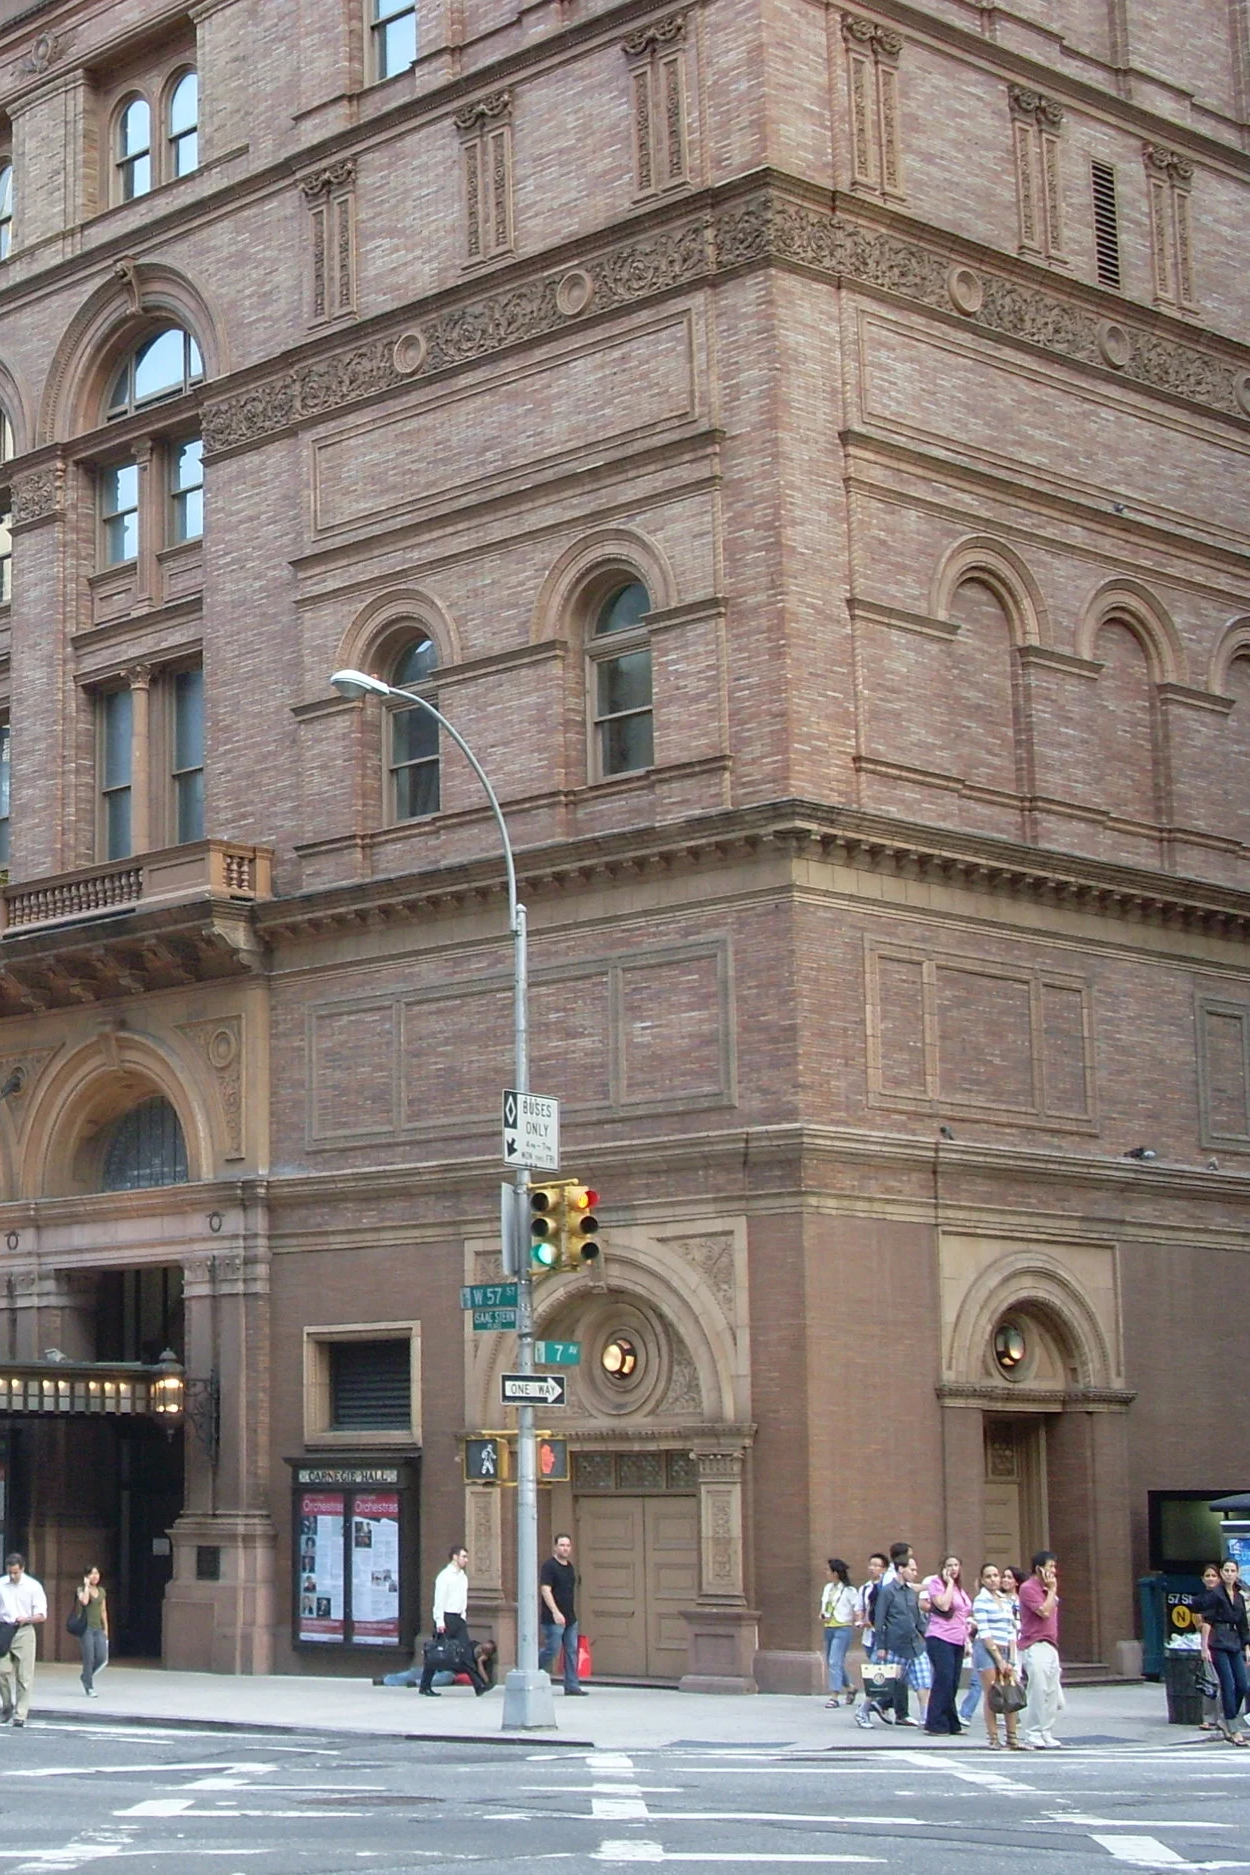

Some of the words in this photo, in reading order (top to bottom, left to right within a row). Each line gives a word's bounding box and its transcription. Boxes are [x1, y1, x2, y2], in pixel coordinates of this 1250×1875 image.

[522, 1099, 552, 1119] BUSES
[526, 1121, 549, 1137] ONLY
[472, 1289, 484, 1305] W
[486, 1287, 503, 1305] 57
[554, 1345, 564, 1361] 7
[510, 1383, 530, 1395] ONE
[537, 1384, 556, 1395] WAY
[308, 1469, 357, 1482] CARNEGIE
[362, 1469, 388, 1482] HALL
[1167, 1593, 1180, 1604] 57
[1177, 1610, 1186, 1622] N
